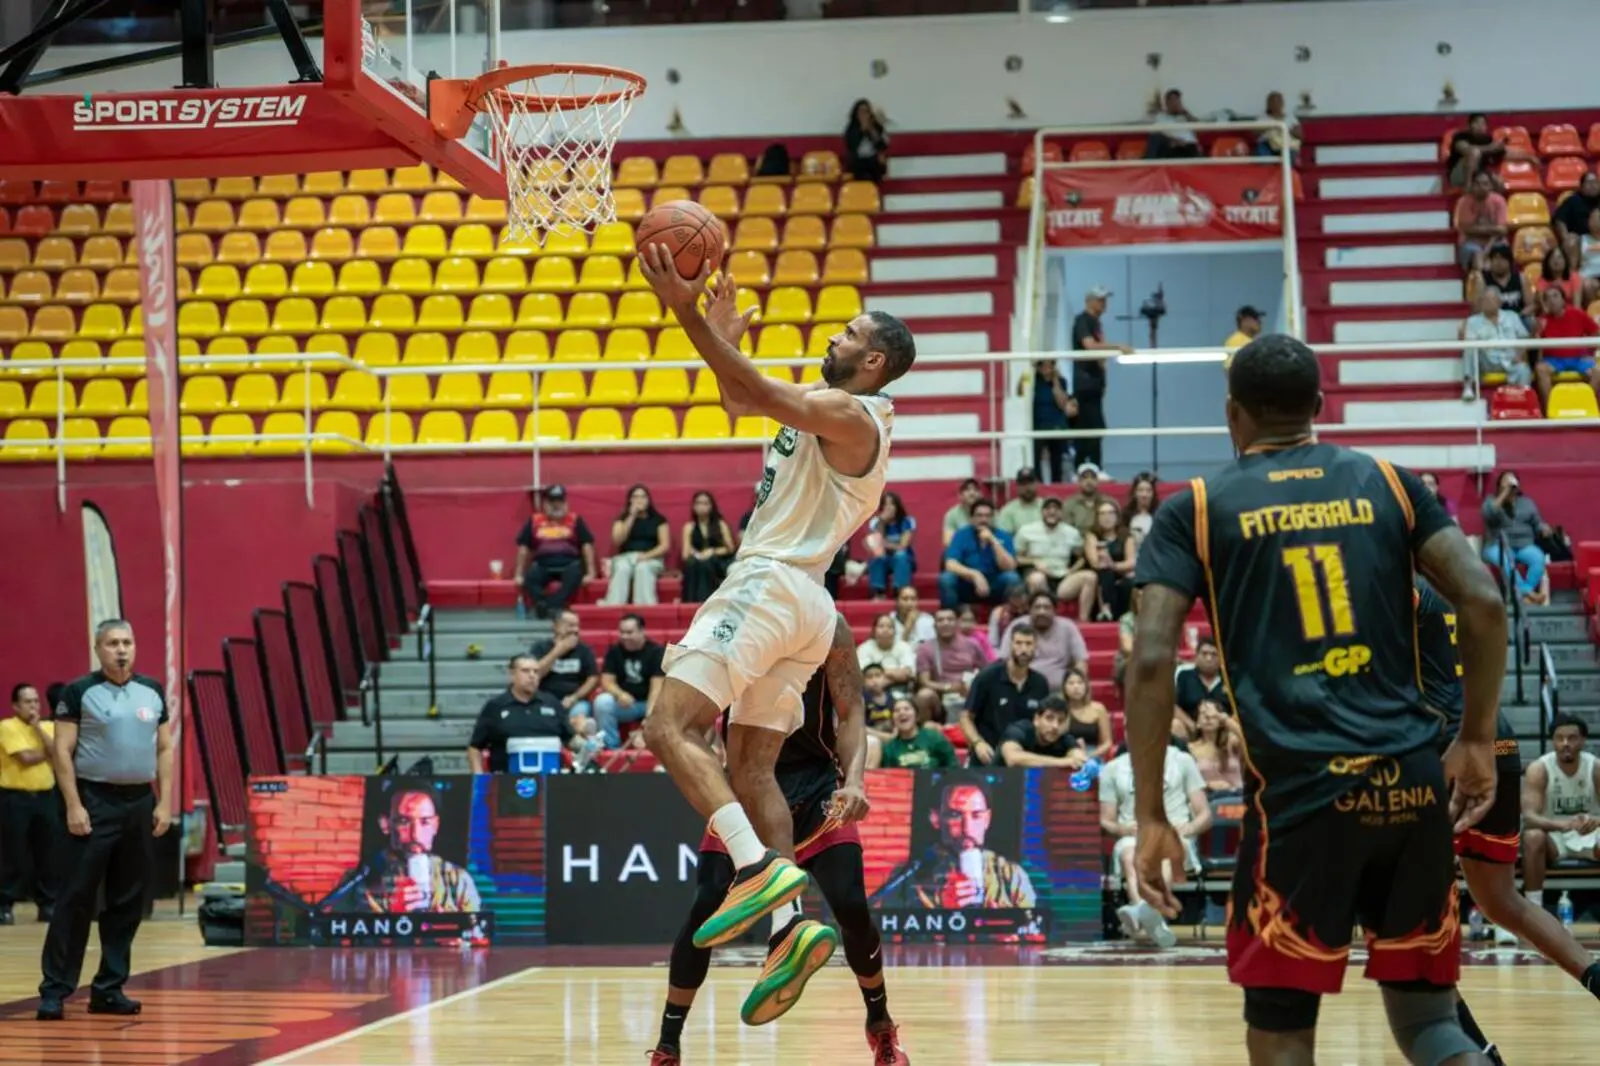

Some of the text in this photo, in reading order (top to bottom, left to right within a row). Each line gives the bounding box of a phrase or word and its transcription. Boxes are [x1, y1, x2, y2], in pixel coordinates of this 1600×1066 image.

[73, 95, 307, 128] SPORTSYSTEM
[1238, 498, 1375, 540] FITZGERALD
[1282, 544, 1354, 639] 11
[1334, 785, 1437, 812] GALENIA
